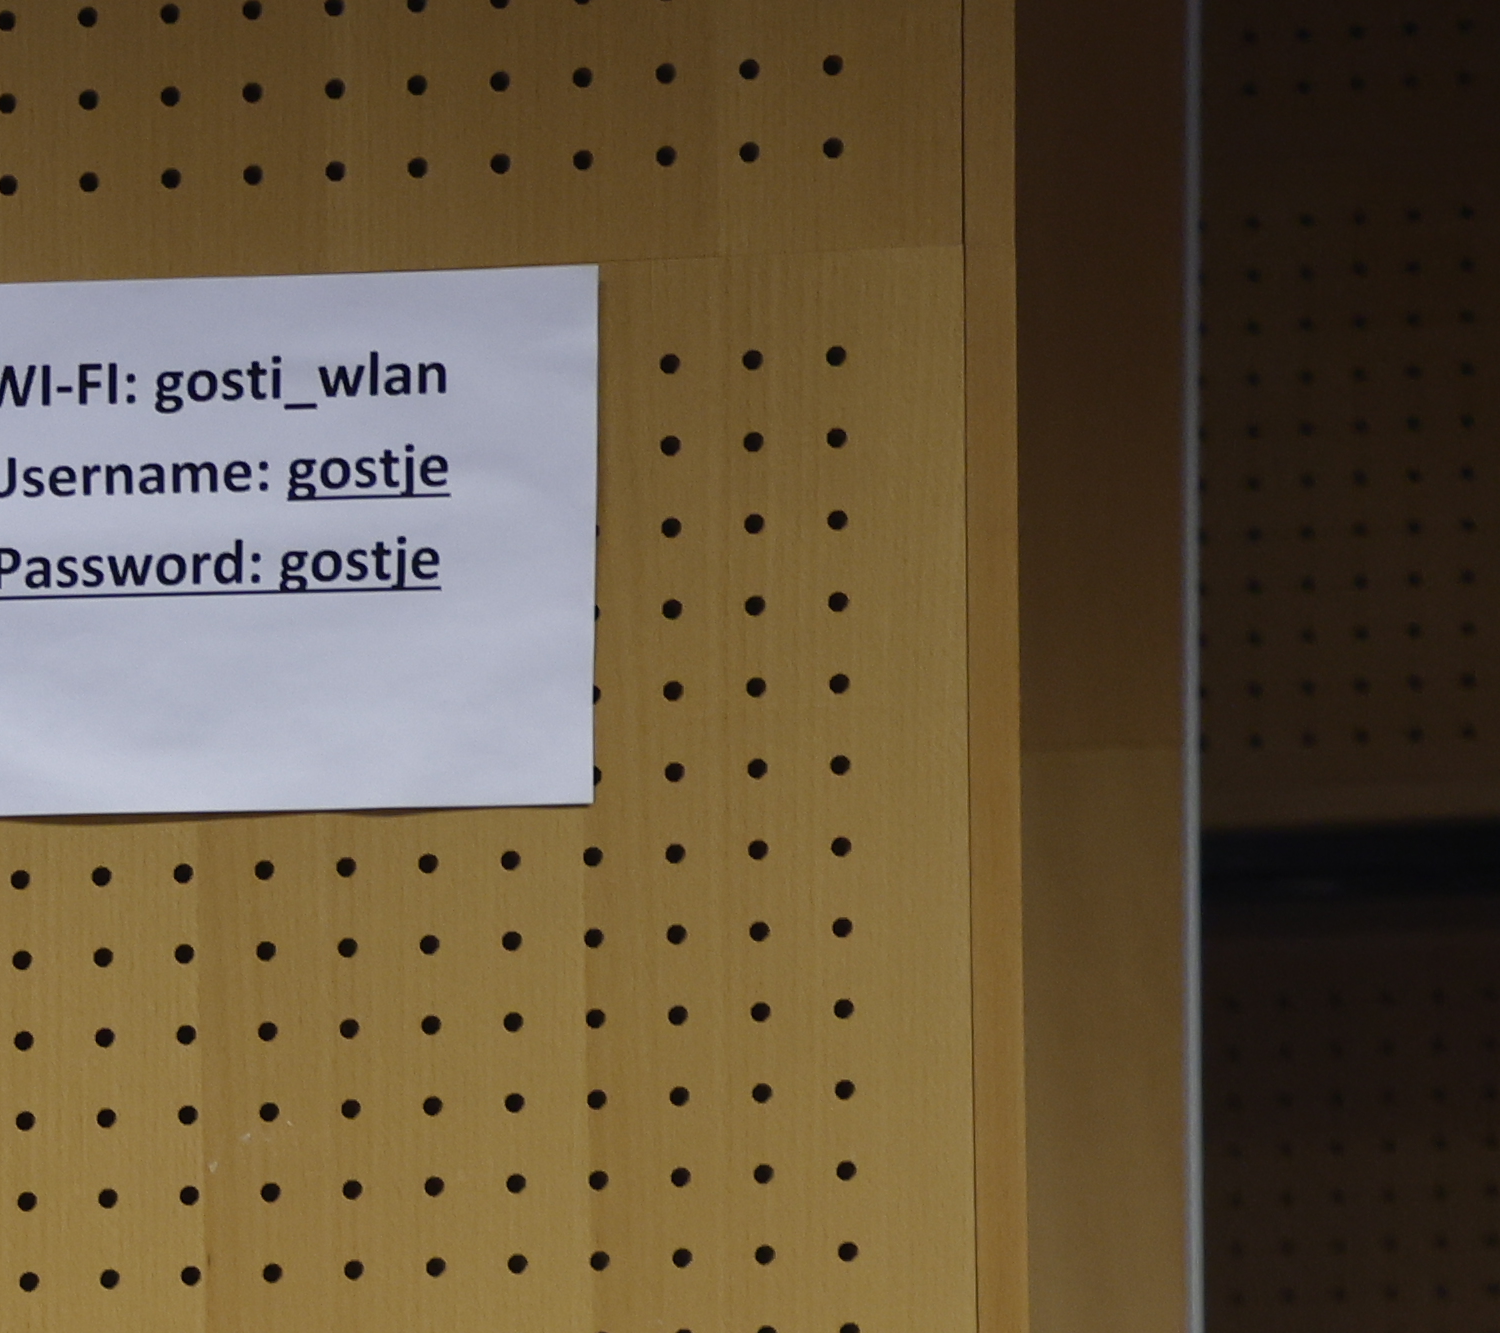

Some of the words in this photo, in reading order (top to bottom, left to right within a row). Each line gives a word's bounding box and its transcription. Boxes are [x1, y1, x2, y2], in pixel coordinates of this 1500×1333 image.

[154, 350, 447, 415] gosti_wlan
[287, 443, 450, 501] gostje
[279, 536, 441, 593] gostje
